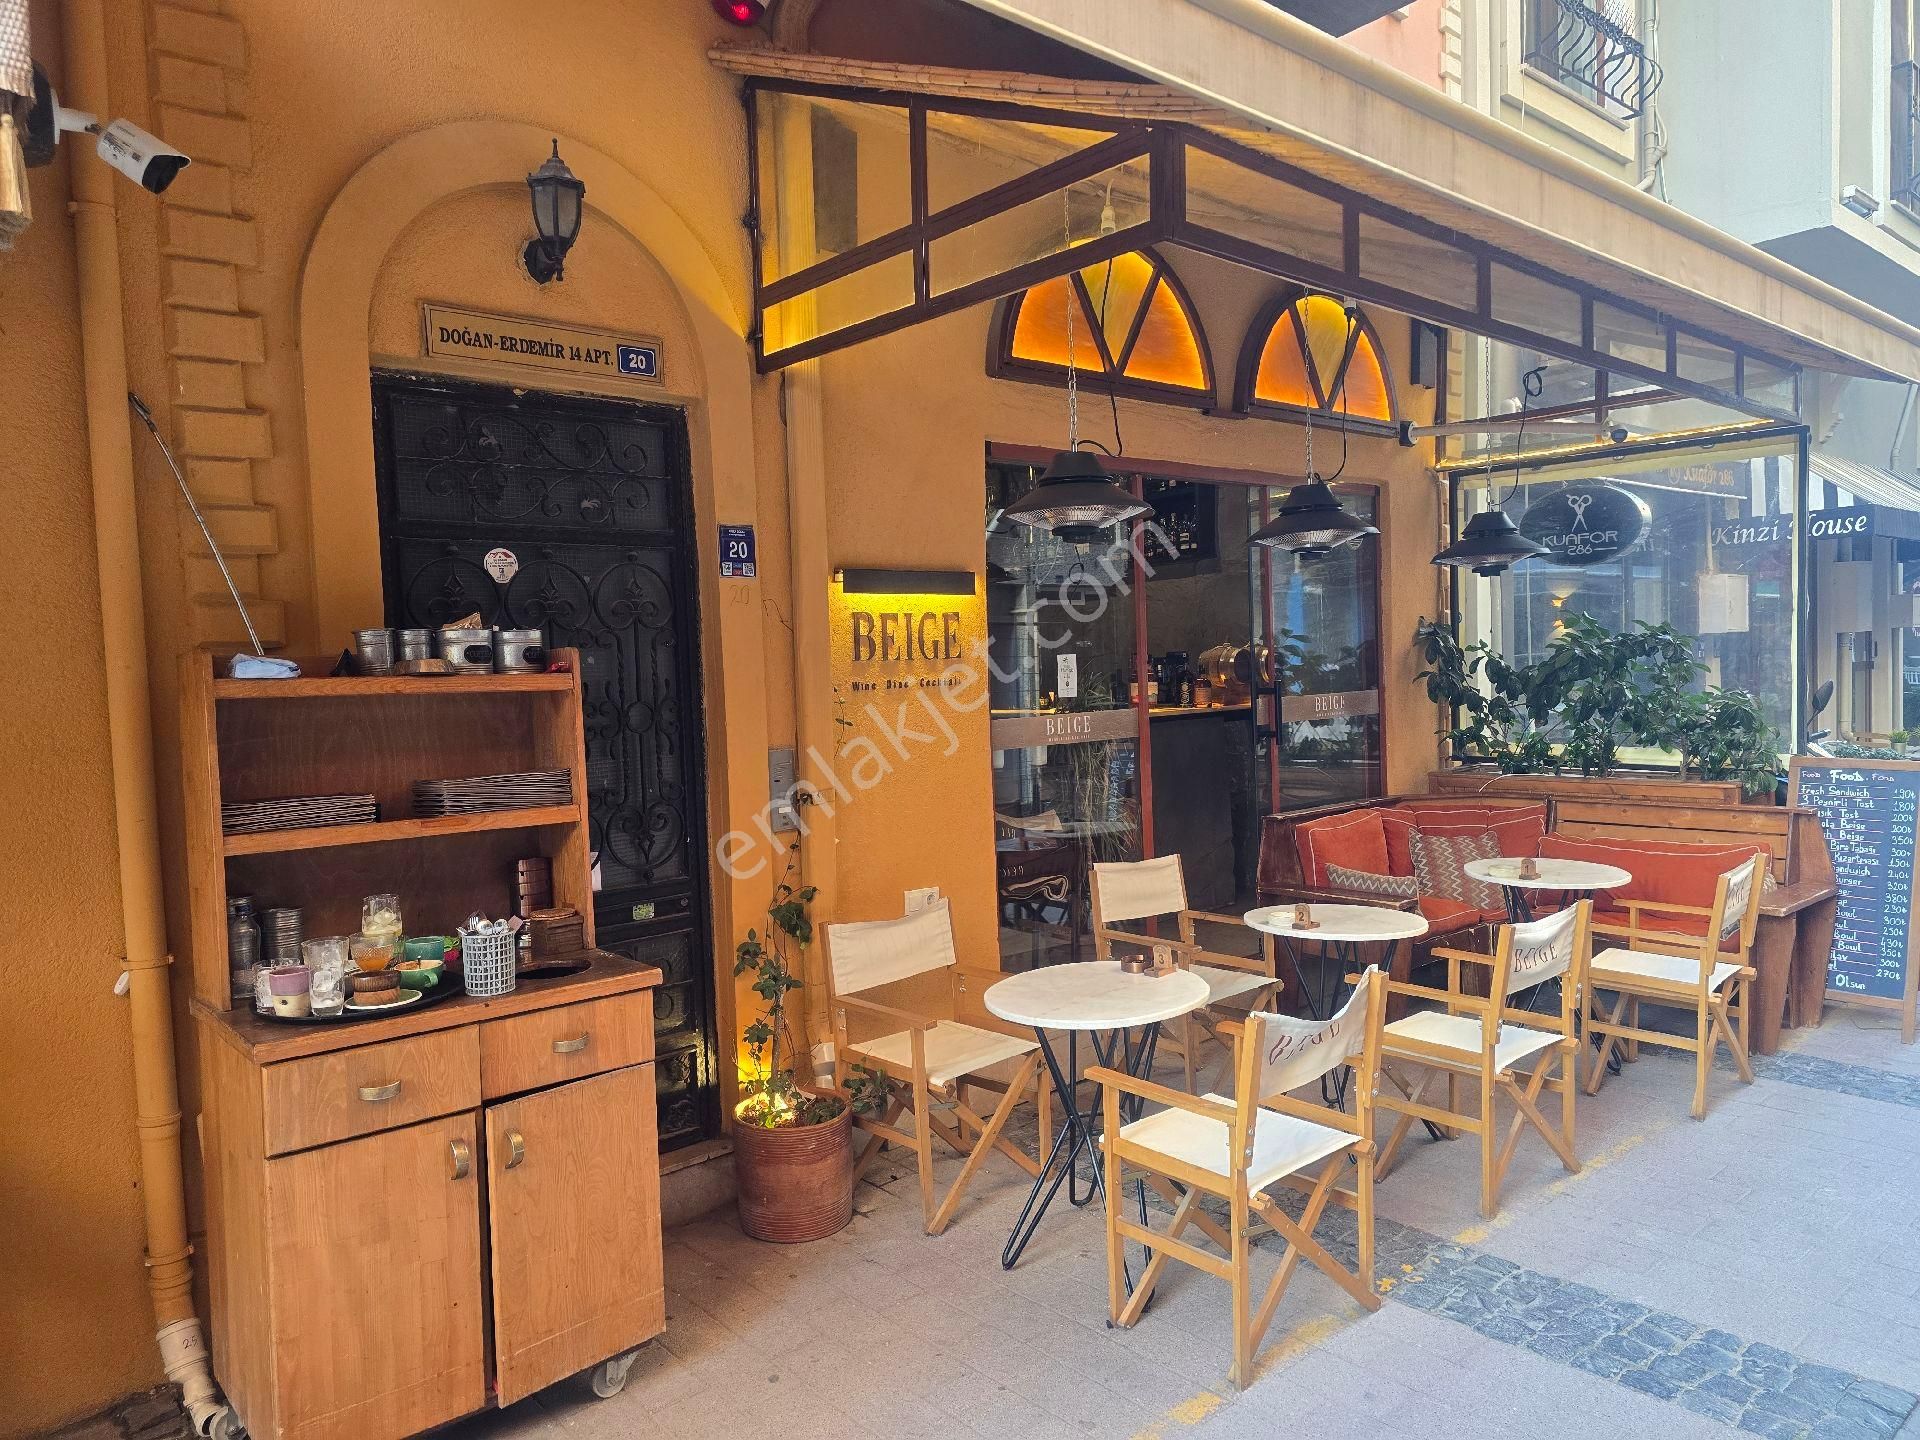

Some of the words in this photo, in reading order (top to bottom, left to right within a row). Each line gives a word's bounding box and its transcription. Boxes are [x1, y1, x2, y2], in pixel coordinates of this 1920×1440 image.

[438, 327, 565, 359] DOĞAN-ERDEMİR
[568, 345, 582, 361] 14
[584, 350, 614, 366] APT.
[628, 353, 646, 369] 20
[1711, 519, 1779, 546] Kinzi
[729, 541, 748, 559] 20
[1567, 544, 1593, 556] 286
[851, 611, 962, 662] BEIGE
[1314, 695, 1345, 712] BEIGE
[1046, 715, 1091, 736] BEIGE
[1801, 785, 1825, 795] Fresh
[1828, 786, 1870, 798] Sandwich
[1813, 796, 1848, 807] Peynirli
[1853, 799, 1875, 809] Tost
[1839, 808, 1860, 819] Tost
[1840, 829, 1865, 841] Beige
[1298, 911, 1305, 922] 2
[1837, 940, 1862, 952] Bowl
[1158, 953, 1165, 965] 3
[1835, 973, 1866, 990] Olsun
